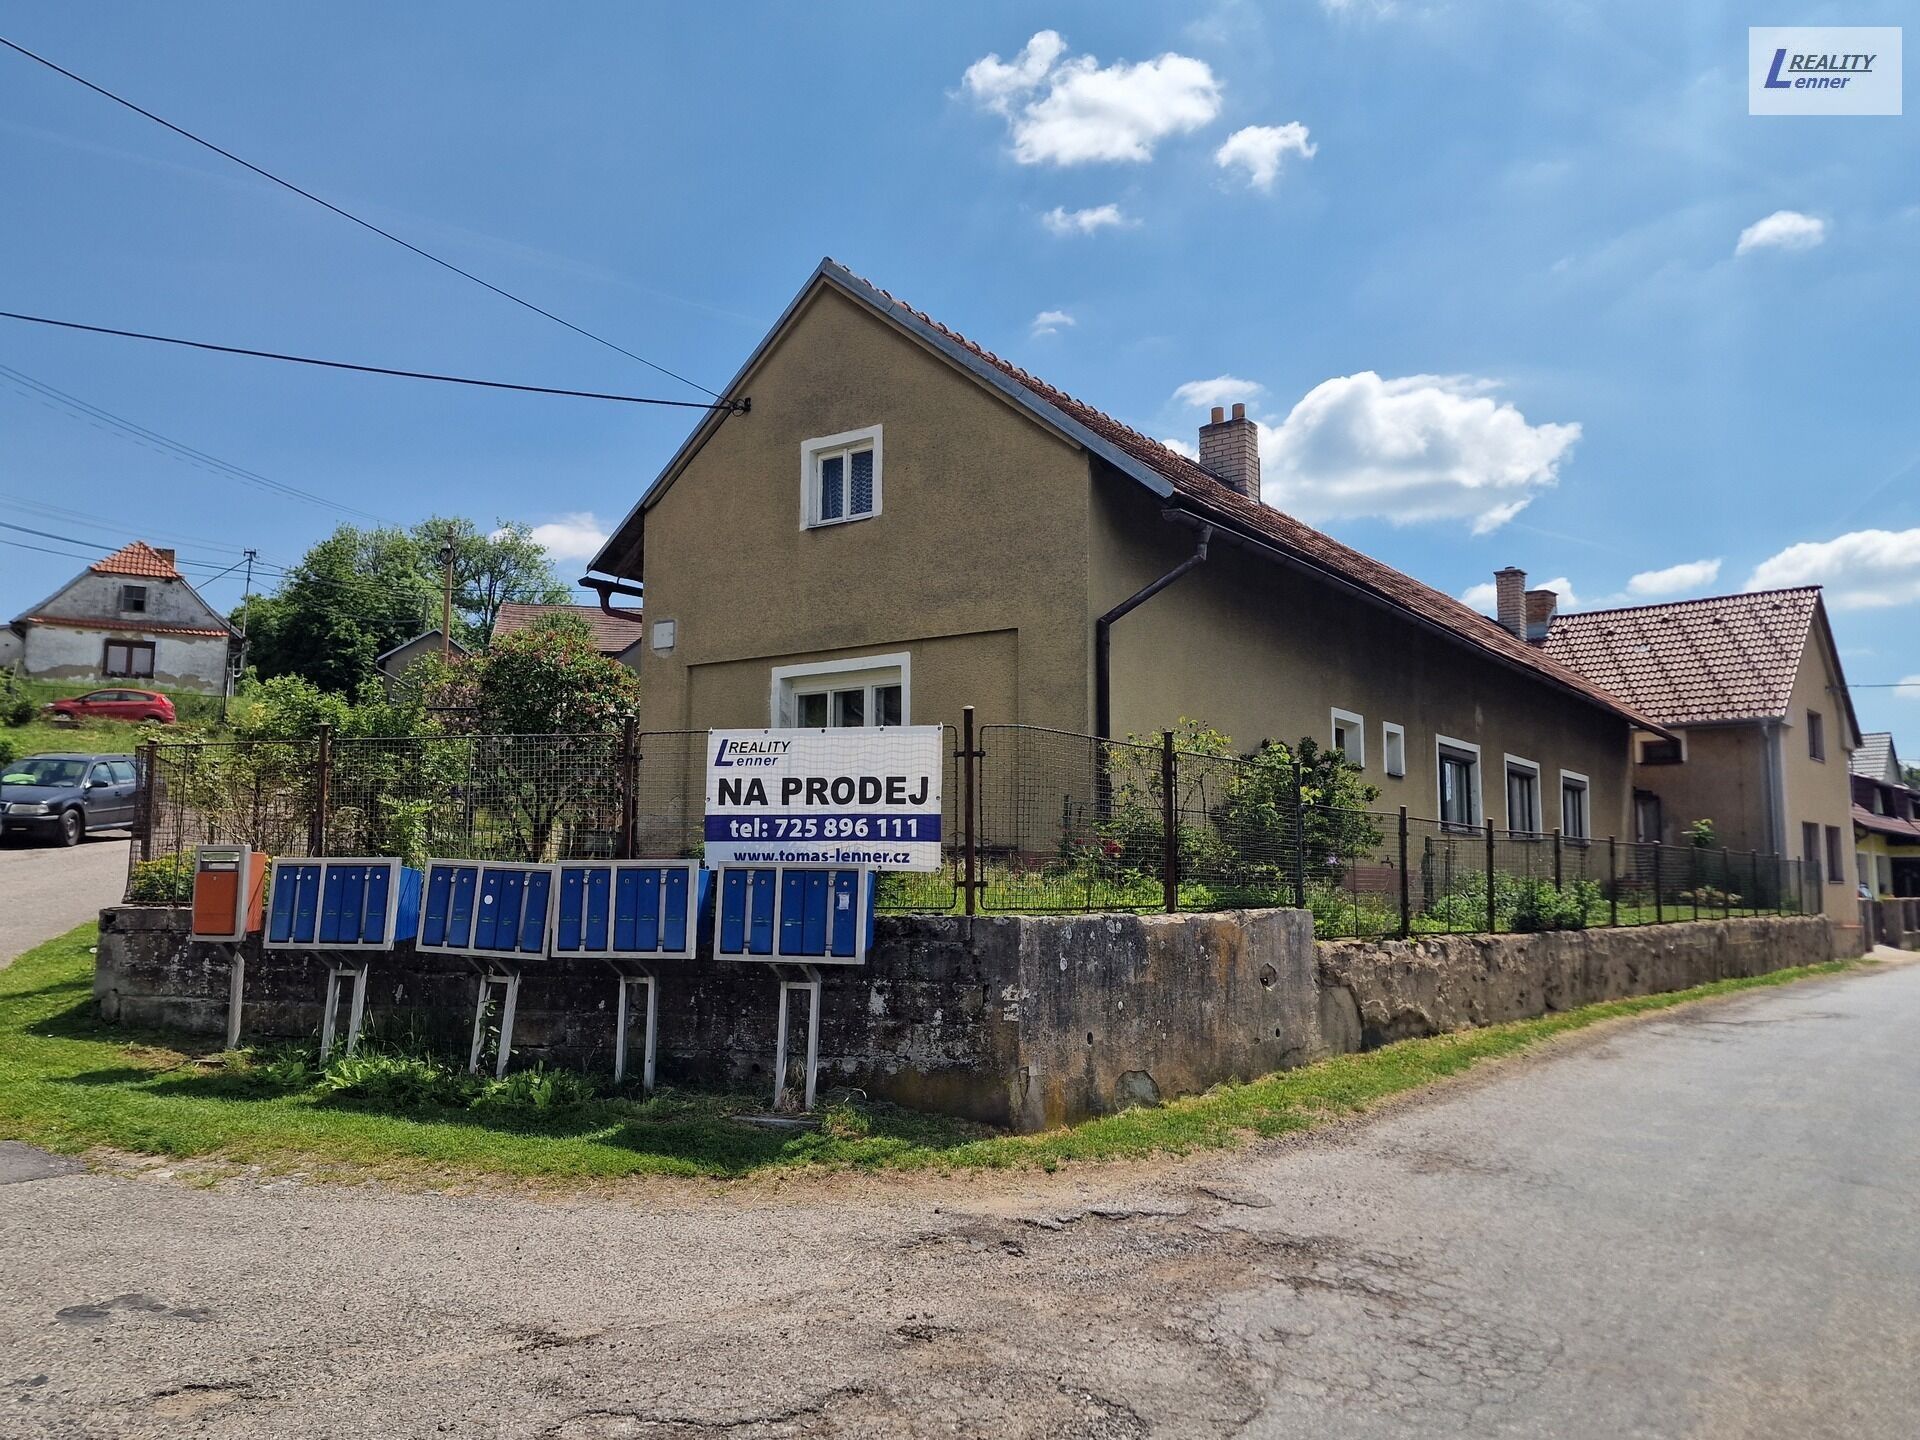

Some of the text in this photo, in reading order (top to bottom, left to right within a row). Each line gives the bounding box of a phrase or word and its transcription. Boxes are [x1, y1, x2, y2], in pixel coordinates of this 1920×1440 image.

[714, 739, 779, 767] Lenner
[728, 741, 791, 754] REALITY
[718, 776, 929, 806] NA PRODEJ
[729, 817, 918, 838] tel: 725 896 111
[733, 848, 910, 863] www.tomas-lenner.cz
